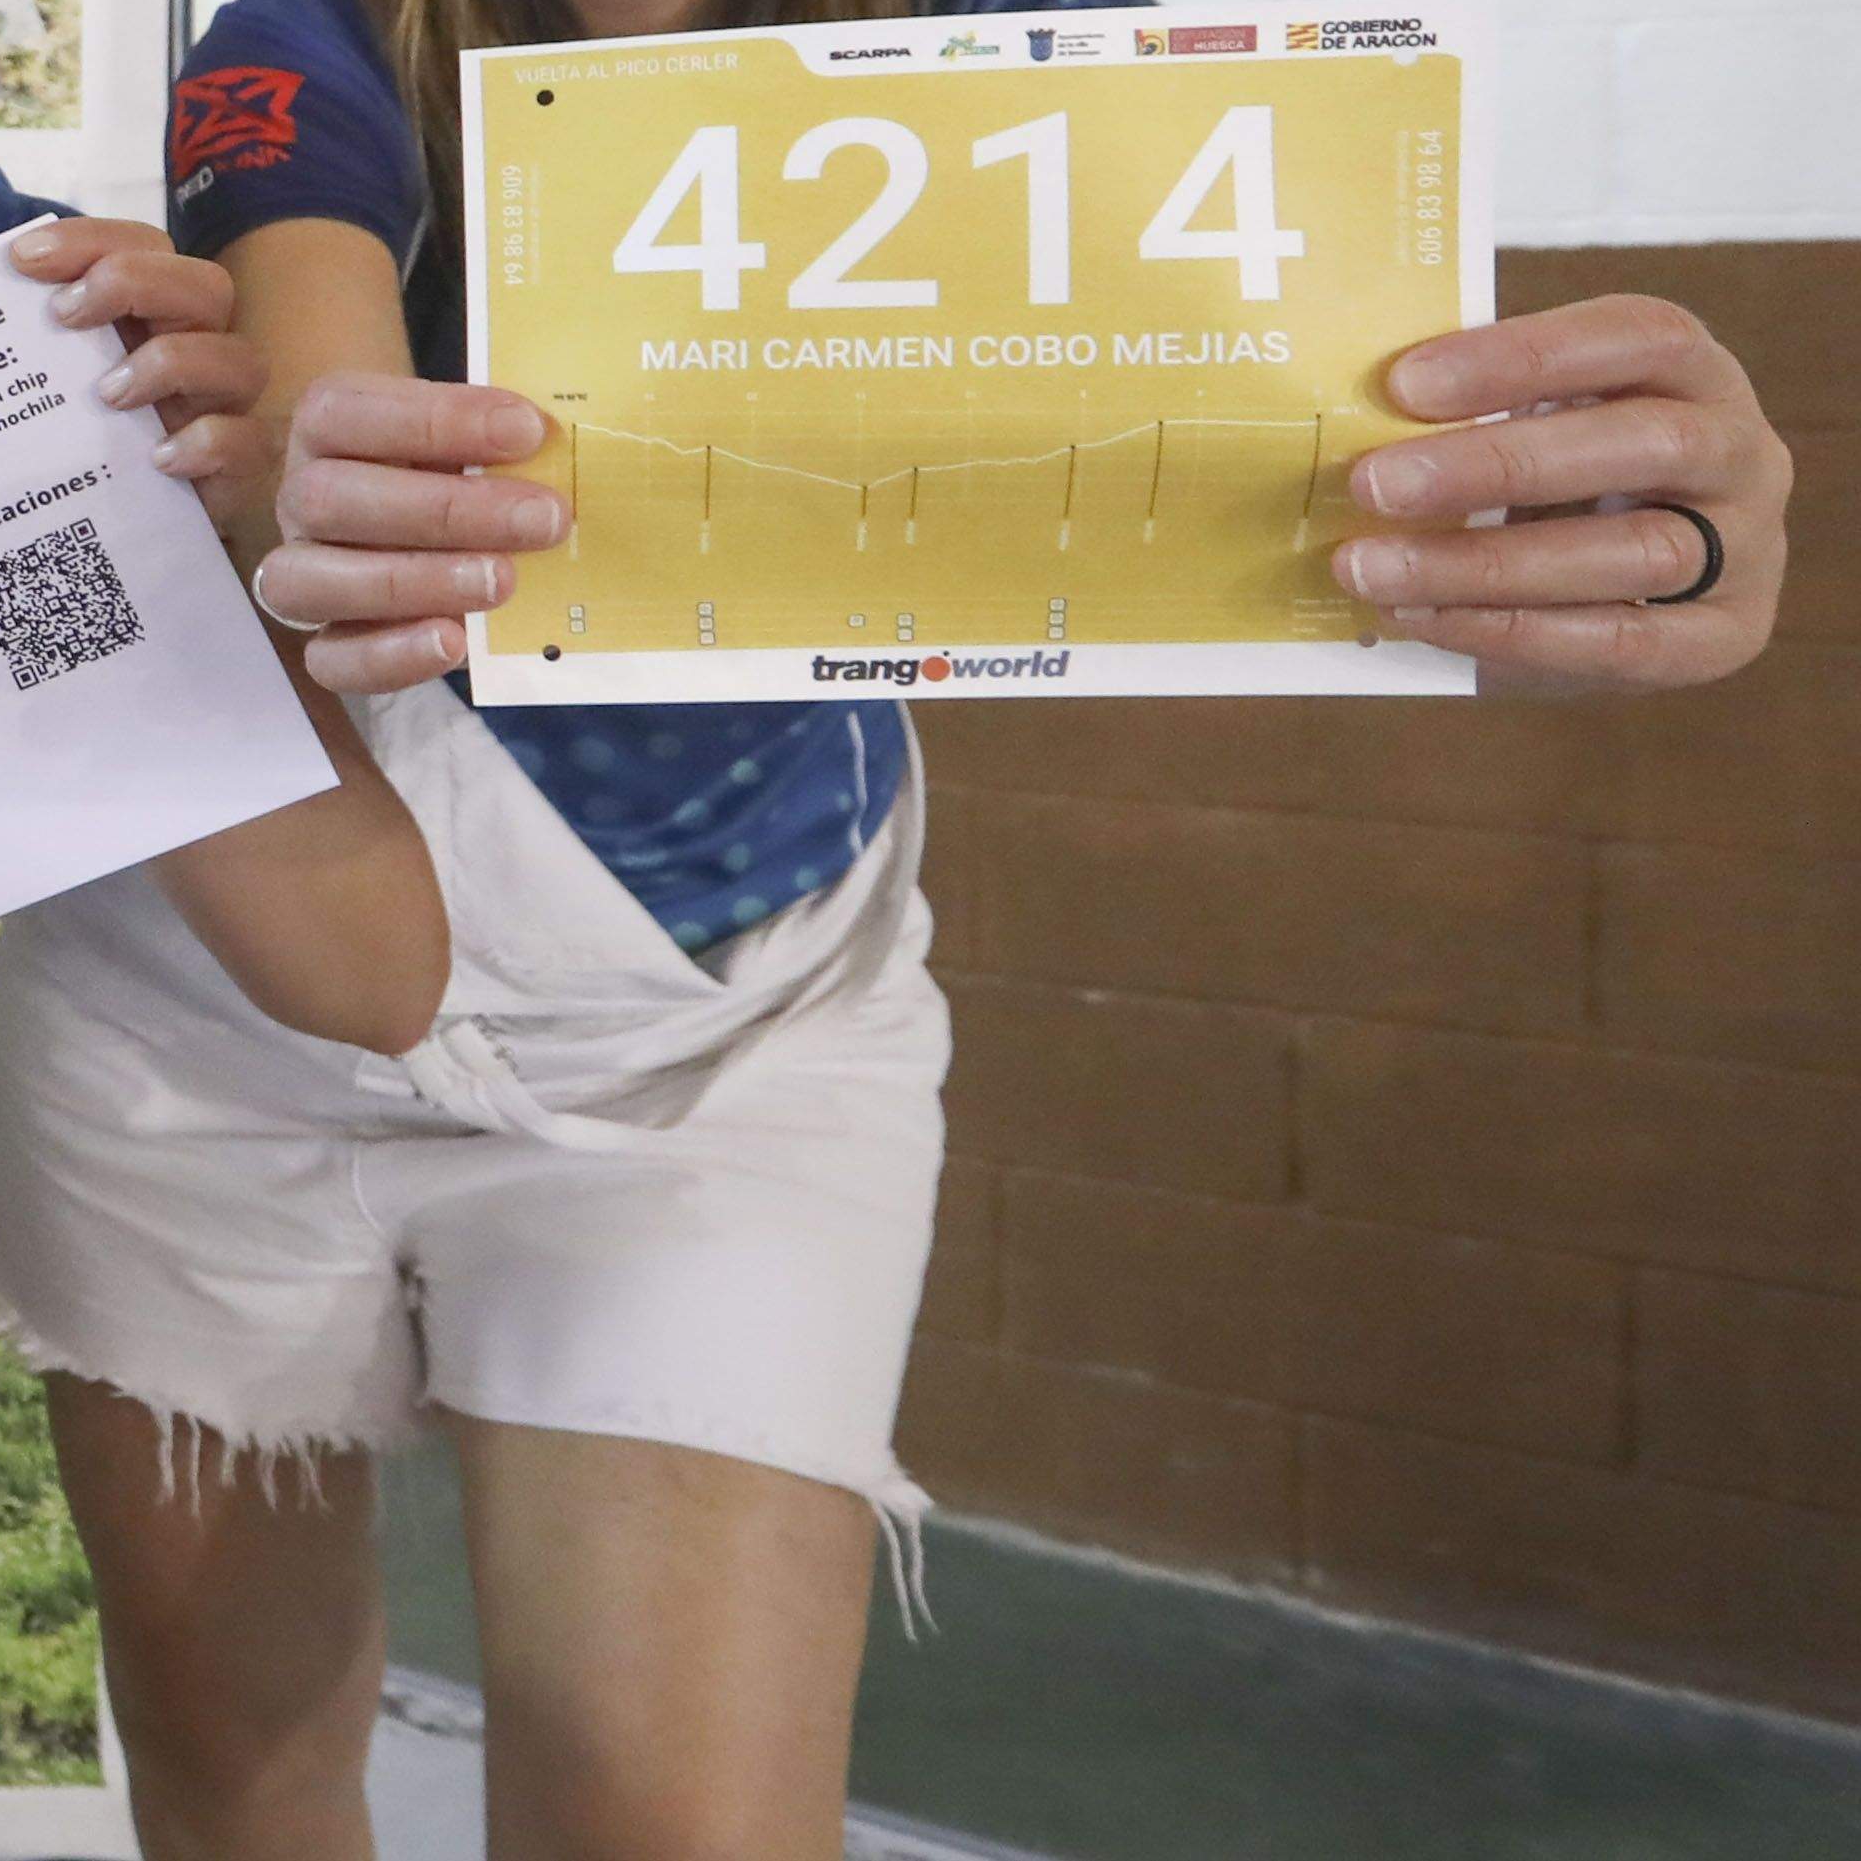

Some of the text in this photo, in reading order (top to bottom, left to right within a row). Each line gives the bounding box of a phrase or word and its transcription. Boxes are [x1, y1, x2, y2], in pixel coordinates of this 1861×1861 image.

[1321, 17, 1422, 36] GOBIERNO
[829, 48, 912, 61] SCARPA
[1193, 40, 1245, 51] HUESCA
[1320, 35, 1347, 50] DE
[514, 53, 739, 83] VUELTA AL PICO CERLER
[611, 104, 1307, 311] 4214
[1415, 130, 1443, 266] 606 83 98 64
[501, 165, 525, 285] 606 83 98 64
[640, 329, 1292, 371] MARI CARMEN COBO MEJIAS
[7, 370, 48, 397] chip
[812, 650, 1070, 686] trangoworld
